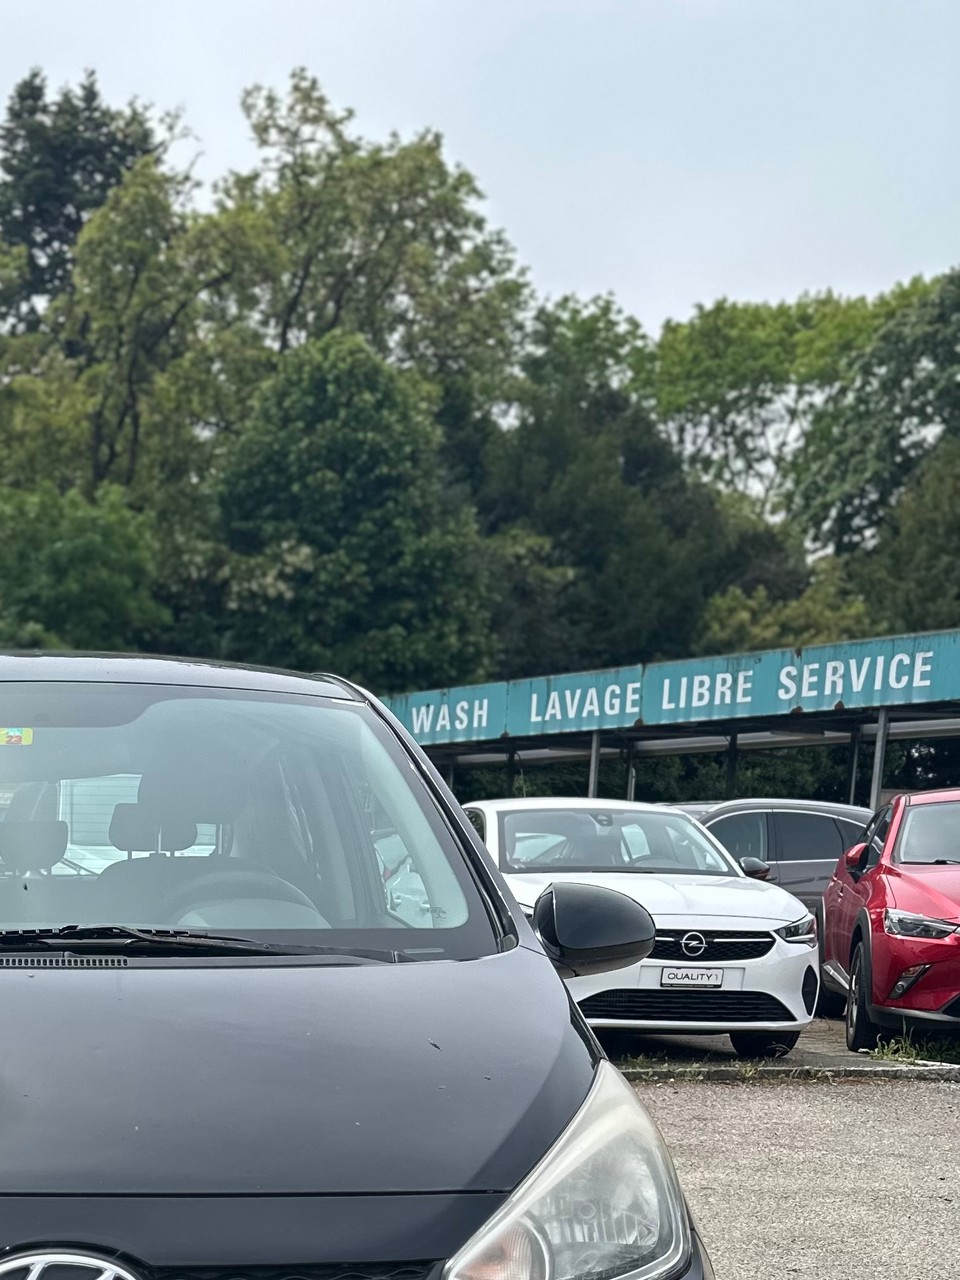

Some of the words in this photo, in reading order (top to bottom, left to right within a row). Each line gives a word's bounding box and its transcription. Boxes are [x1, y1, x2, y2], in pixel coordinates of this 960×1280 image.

[411, 698, 489, 735] WASH
[529, 682, 642, 723] LAVAGE
[661, 669, 754, 711] LIBRE
[776, 650, 935, 701] SERVICE
[667, 972, 713, 981] QUALITY
